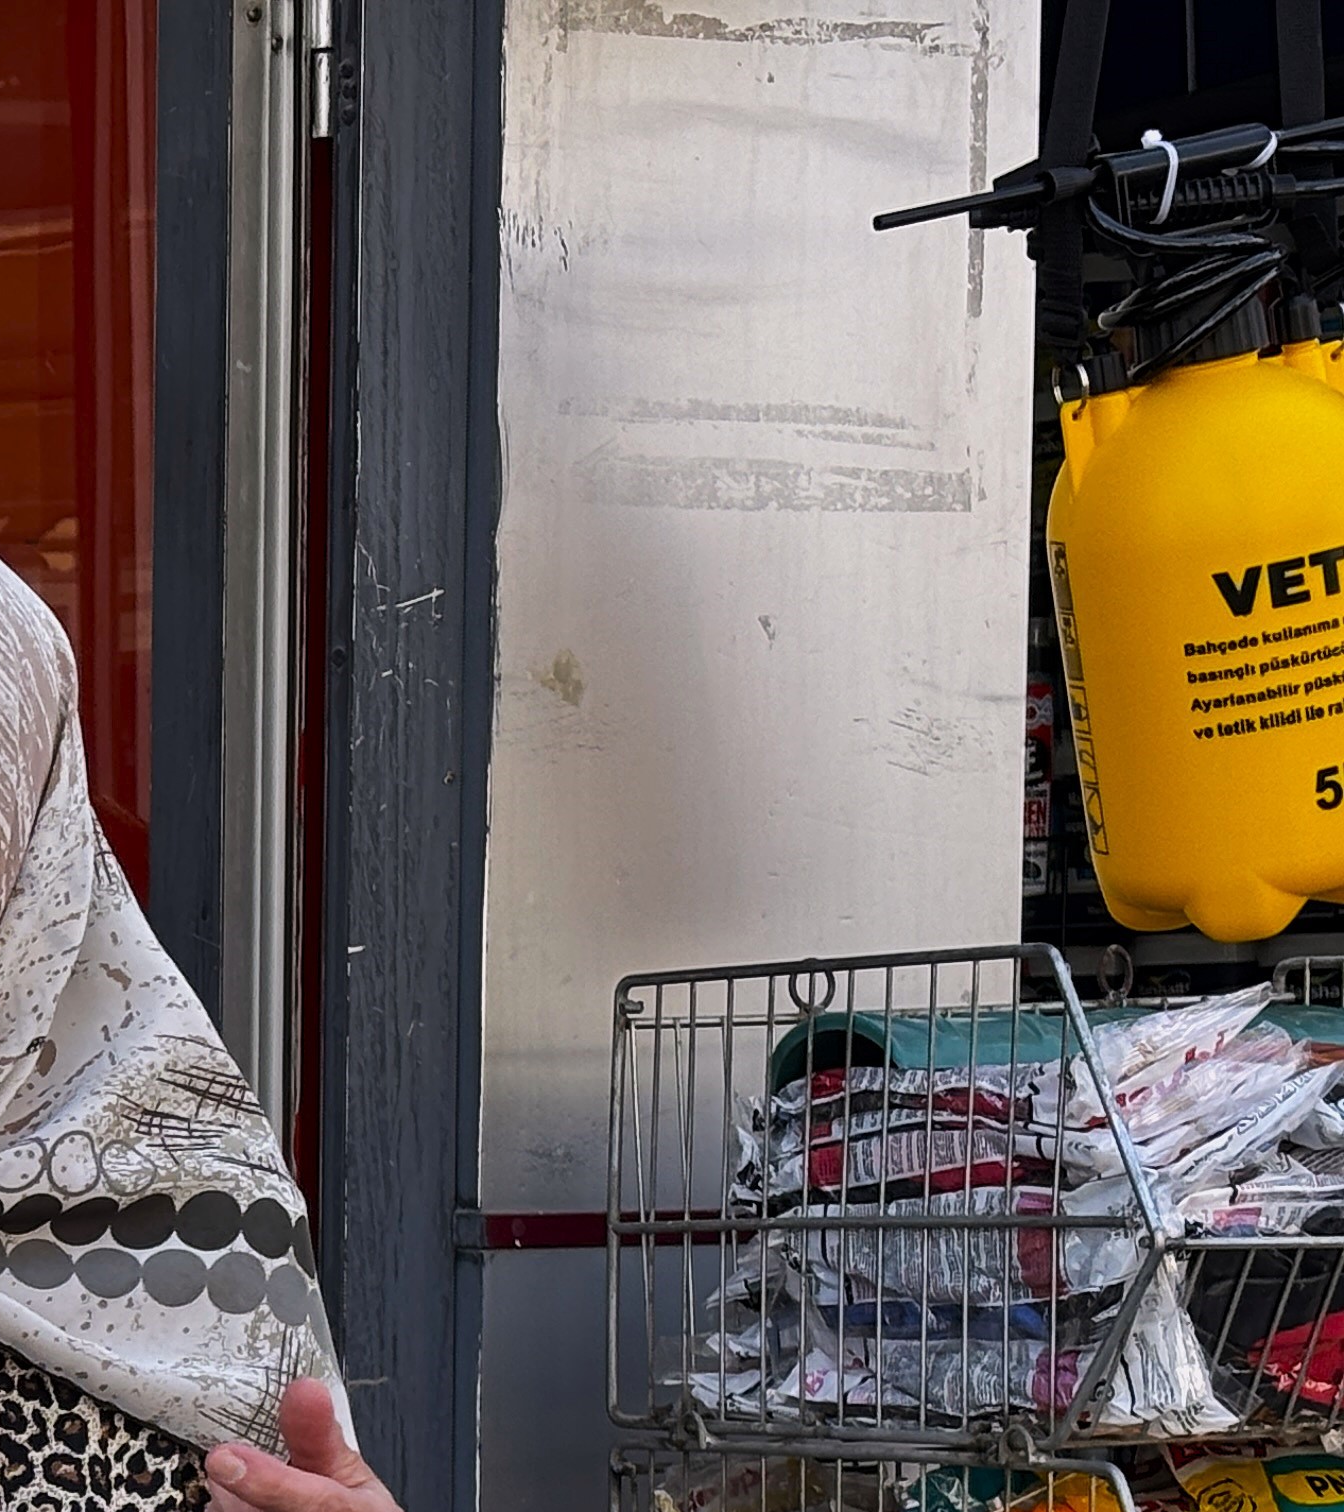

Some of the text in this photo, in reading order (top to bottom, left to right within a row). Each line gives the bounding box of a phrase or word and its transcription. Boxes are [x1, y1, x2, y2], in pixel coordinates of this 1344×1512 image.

[1183, 616, 1340, 658] Bahçede kullanıma
[1190, 680, 1301, 713] Ayarlanabilir
[1192, 725, 1215, 741] ve
[1217, 717, 1257, 738] tetik
